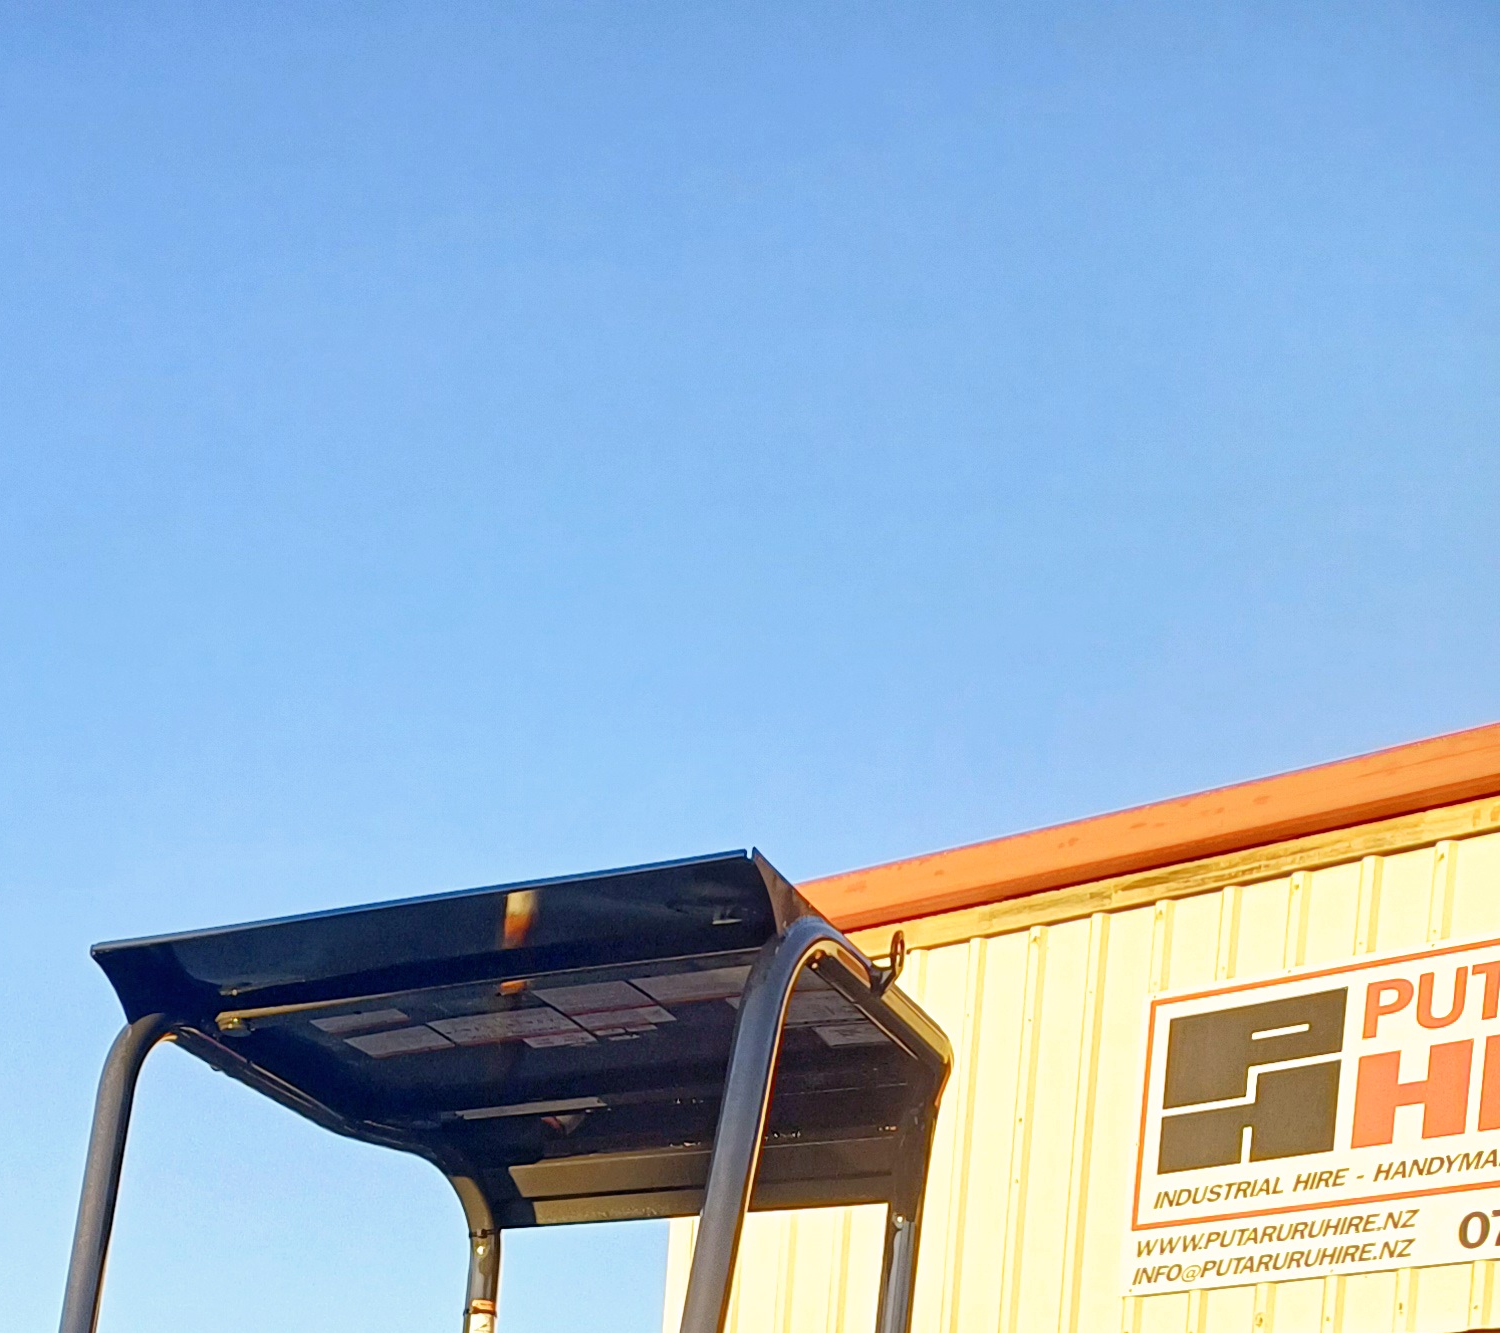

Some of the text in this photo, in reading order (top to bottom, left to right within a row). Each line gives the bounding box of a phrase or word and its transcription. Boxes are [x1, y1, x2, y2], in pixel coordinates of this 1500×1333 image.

[1362, 961, 1500, 1040] PUT
[1153, 1176, 1284, 1210] INDUSTRIAL
[1292, 1167, 1350, 1192] HIRE
[1372, 1149, 1500, 1182] HANDYMA
[1136, 1209, 1500, 1258] WWW.PUTARURUHIRE.NZ 0
[1132, 1238, 1416, 1285] INFO@PUTARURUHIRE.NZ
